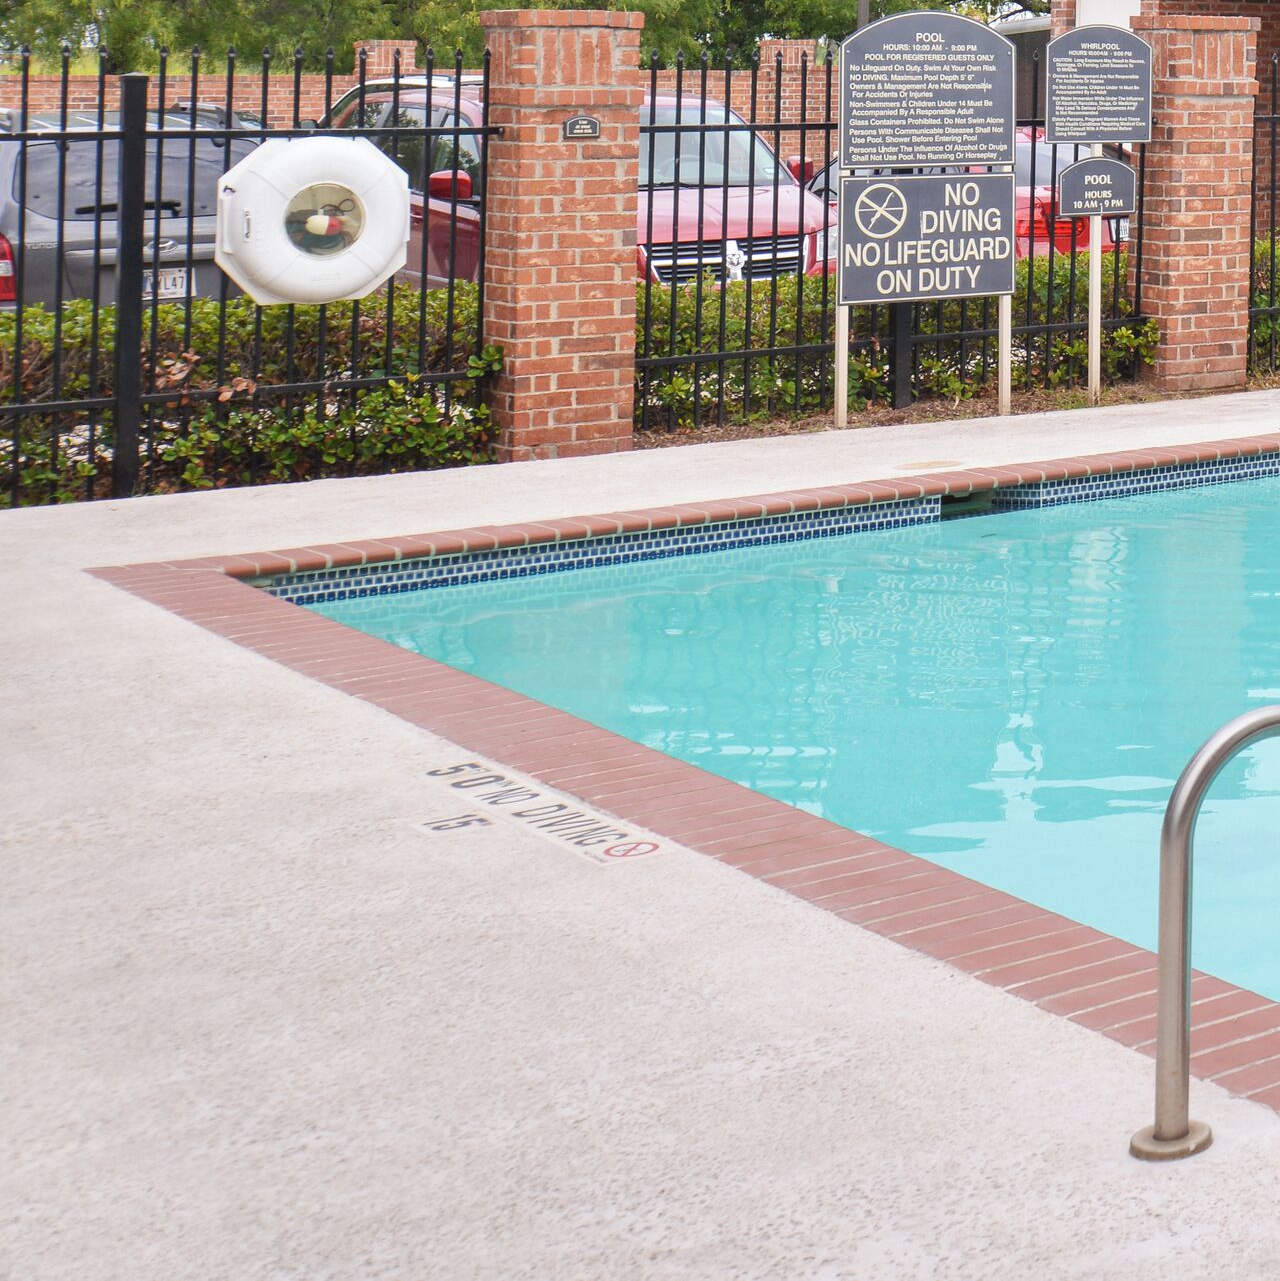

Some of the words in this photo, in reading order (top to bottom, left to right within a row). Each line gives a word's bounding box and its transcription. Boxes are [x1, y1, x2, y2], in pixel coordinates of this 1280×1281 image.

[915, 33, 945, 42] POOL
[927, 153, 954, 161] Running
[965, 152, 997, 161] Horseplay
[1085, 175, 1112, 185] POOL
[945, 182, 980, 206] NO
[1085, 190, 1112, 199] HOURS
[922, 208, 1001, 234] DIVING
[845, 242, 881, 267] NO
[884, 237, 1010, 265] LIFEGUARD
[877, 269, 912, 295] ON
[919, 265, 981, 292] DUTY
[474, 786, 540, 806] NO
[511, 804, 628, 848] DIVING
